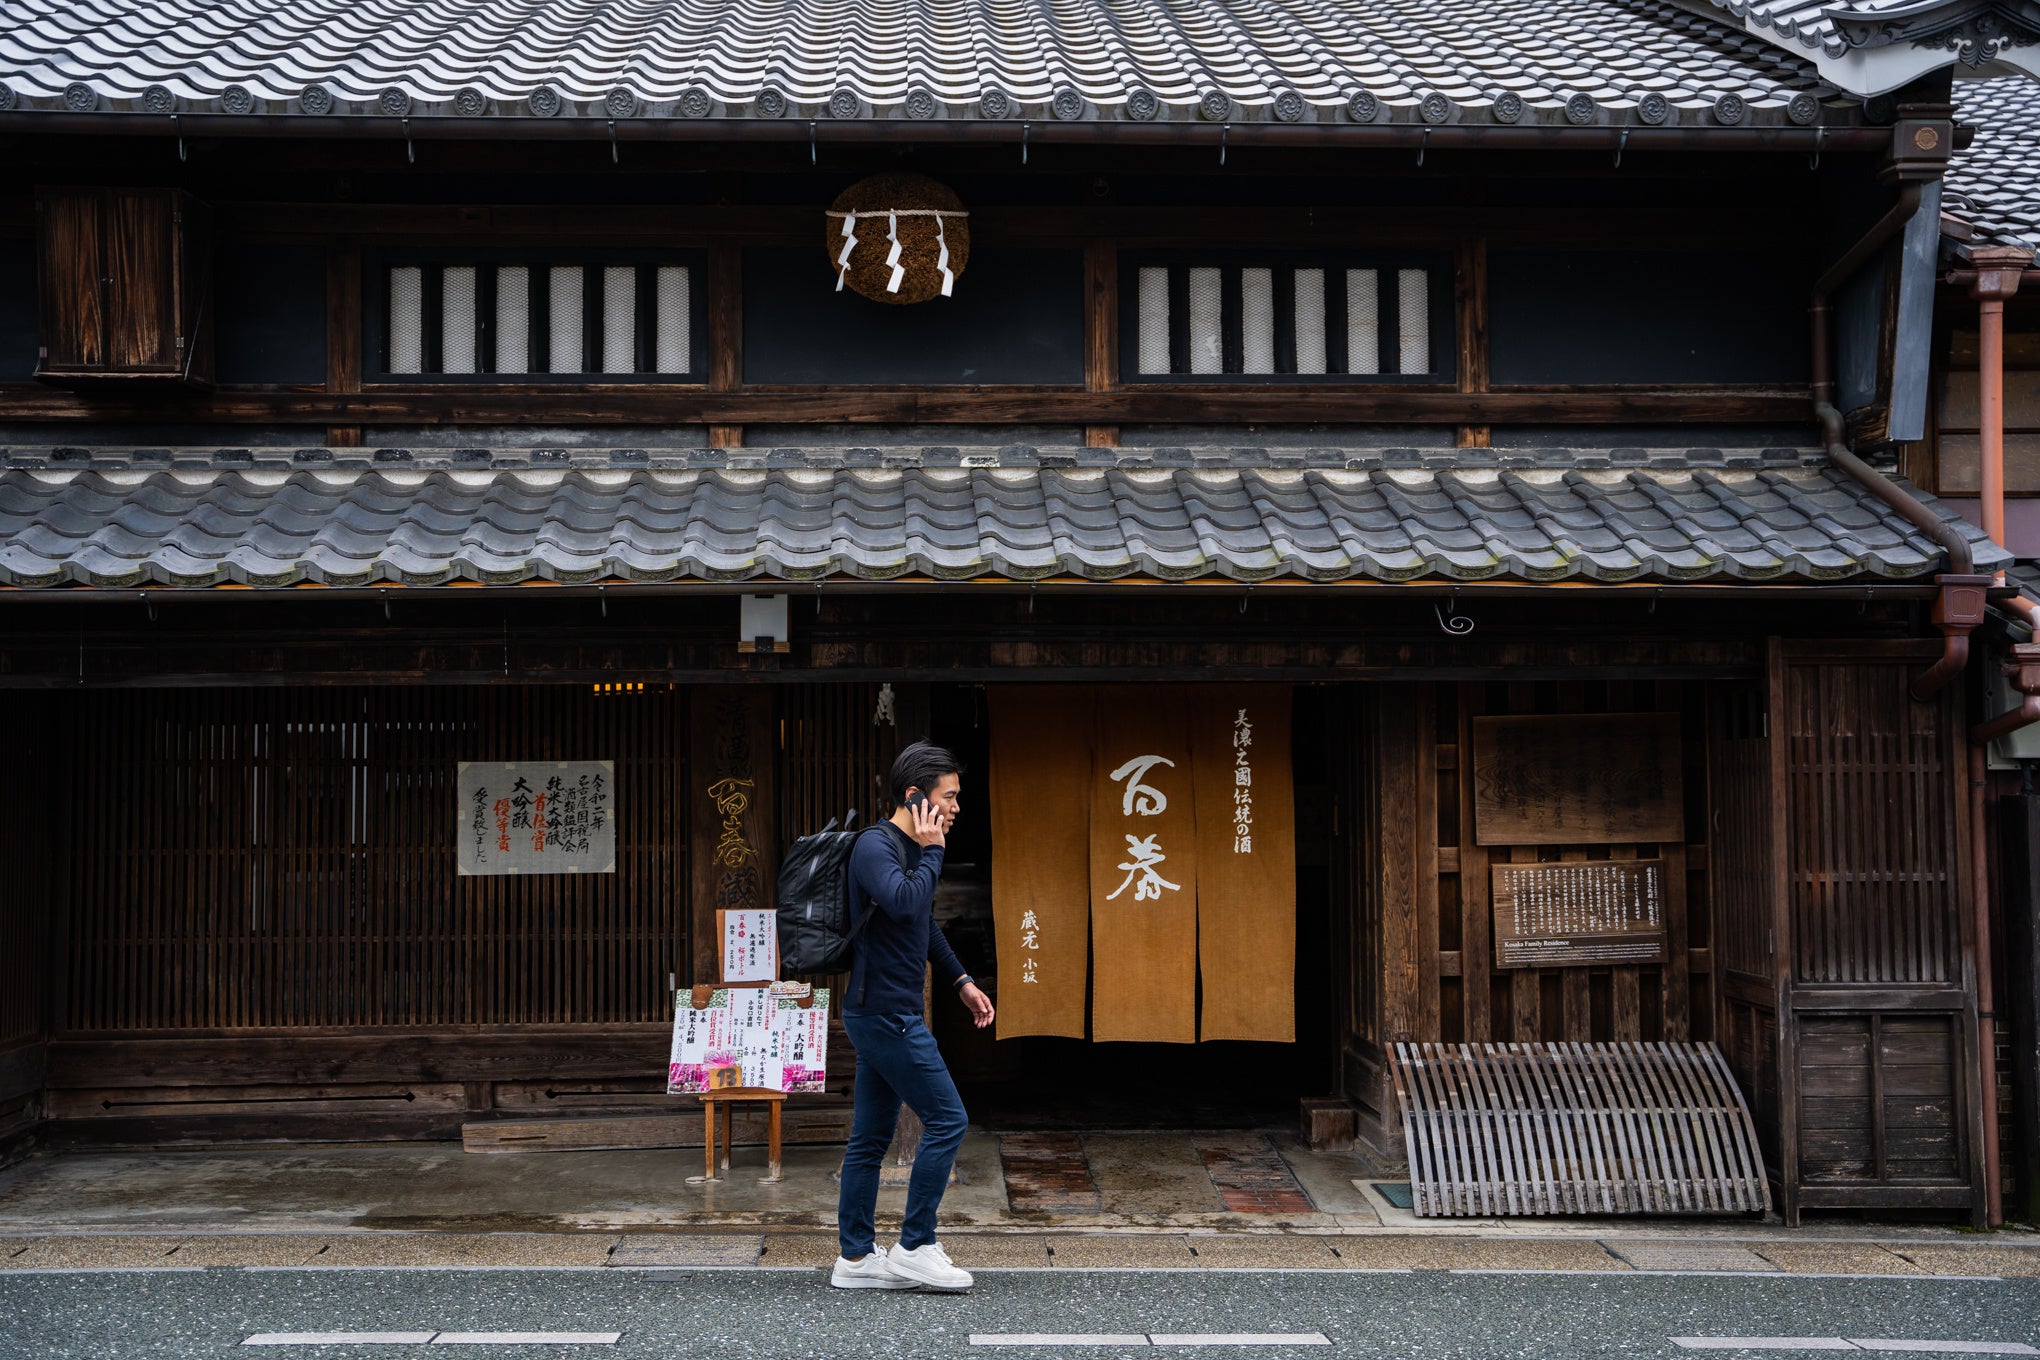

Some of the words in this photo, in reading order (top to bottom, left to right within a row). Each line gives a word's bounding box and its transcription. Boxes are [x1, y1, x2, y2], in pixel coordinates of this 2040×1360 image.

[511, 776, 533, 829] 大吟醸
[589, 774, 606, 831] 令和二年
[1233, 708, 1253, 853] 美濃之國伝統の酒
[493, 797, 511, 852] 優等賞
[545, 776, 564, 847] 純米大吟醸
[576, 775, 591, 854] 名古屋国税局
[1106, 755, 1180, 901] 百春
[1020, 909, 1039, 949] 蔵元
[1504, 940, 1524, 948] Kosaka
[1524, 940, 1543, 948] Family
[1022, 958, 1038, 983] 小坂
[793, 1033, 805, 1061] 大吟醸
